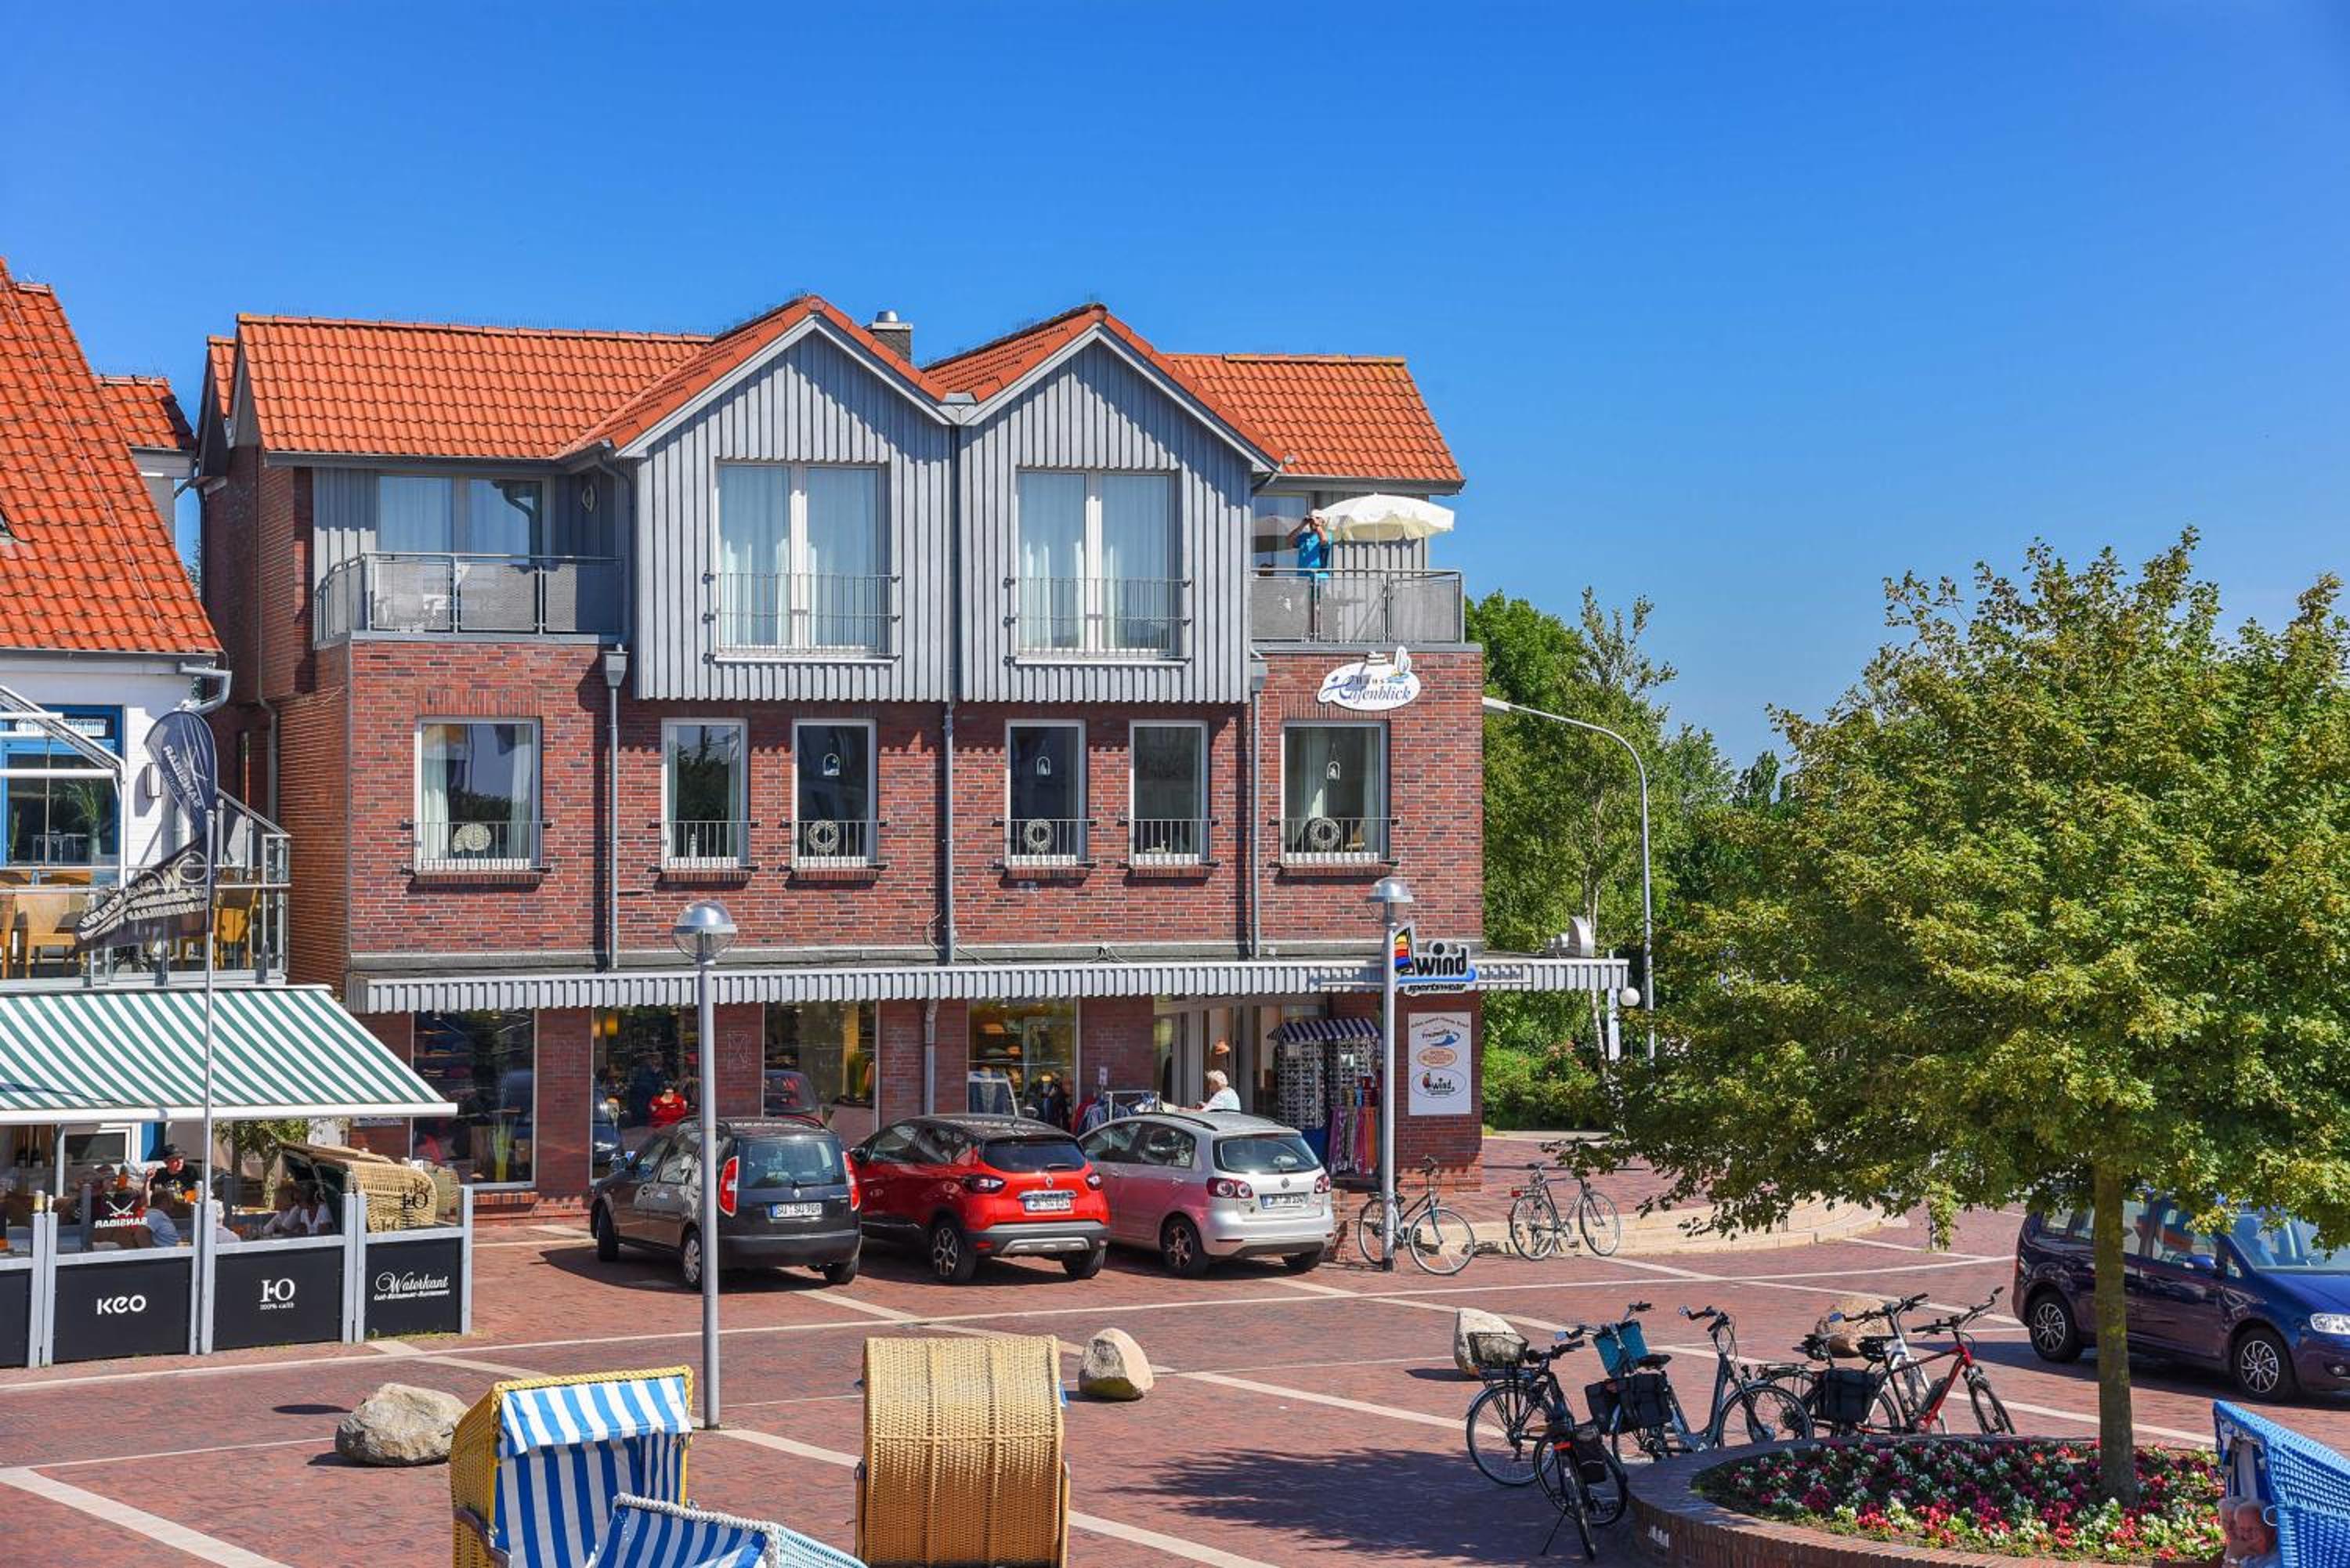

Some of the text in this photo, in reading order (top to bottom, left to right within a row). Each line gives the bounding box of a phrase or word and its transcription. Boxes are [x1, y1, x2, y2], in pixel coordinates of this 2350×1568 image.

[1321, 674, 1411, 704] Hafenblick
[1415, 942, 1467, 977] wind
[1407, 983, 1466, 994] sportswear
[376, 1271, 449, 1294] Waterkant
